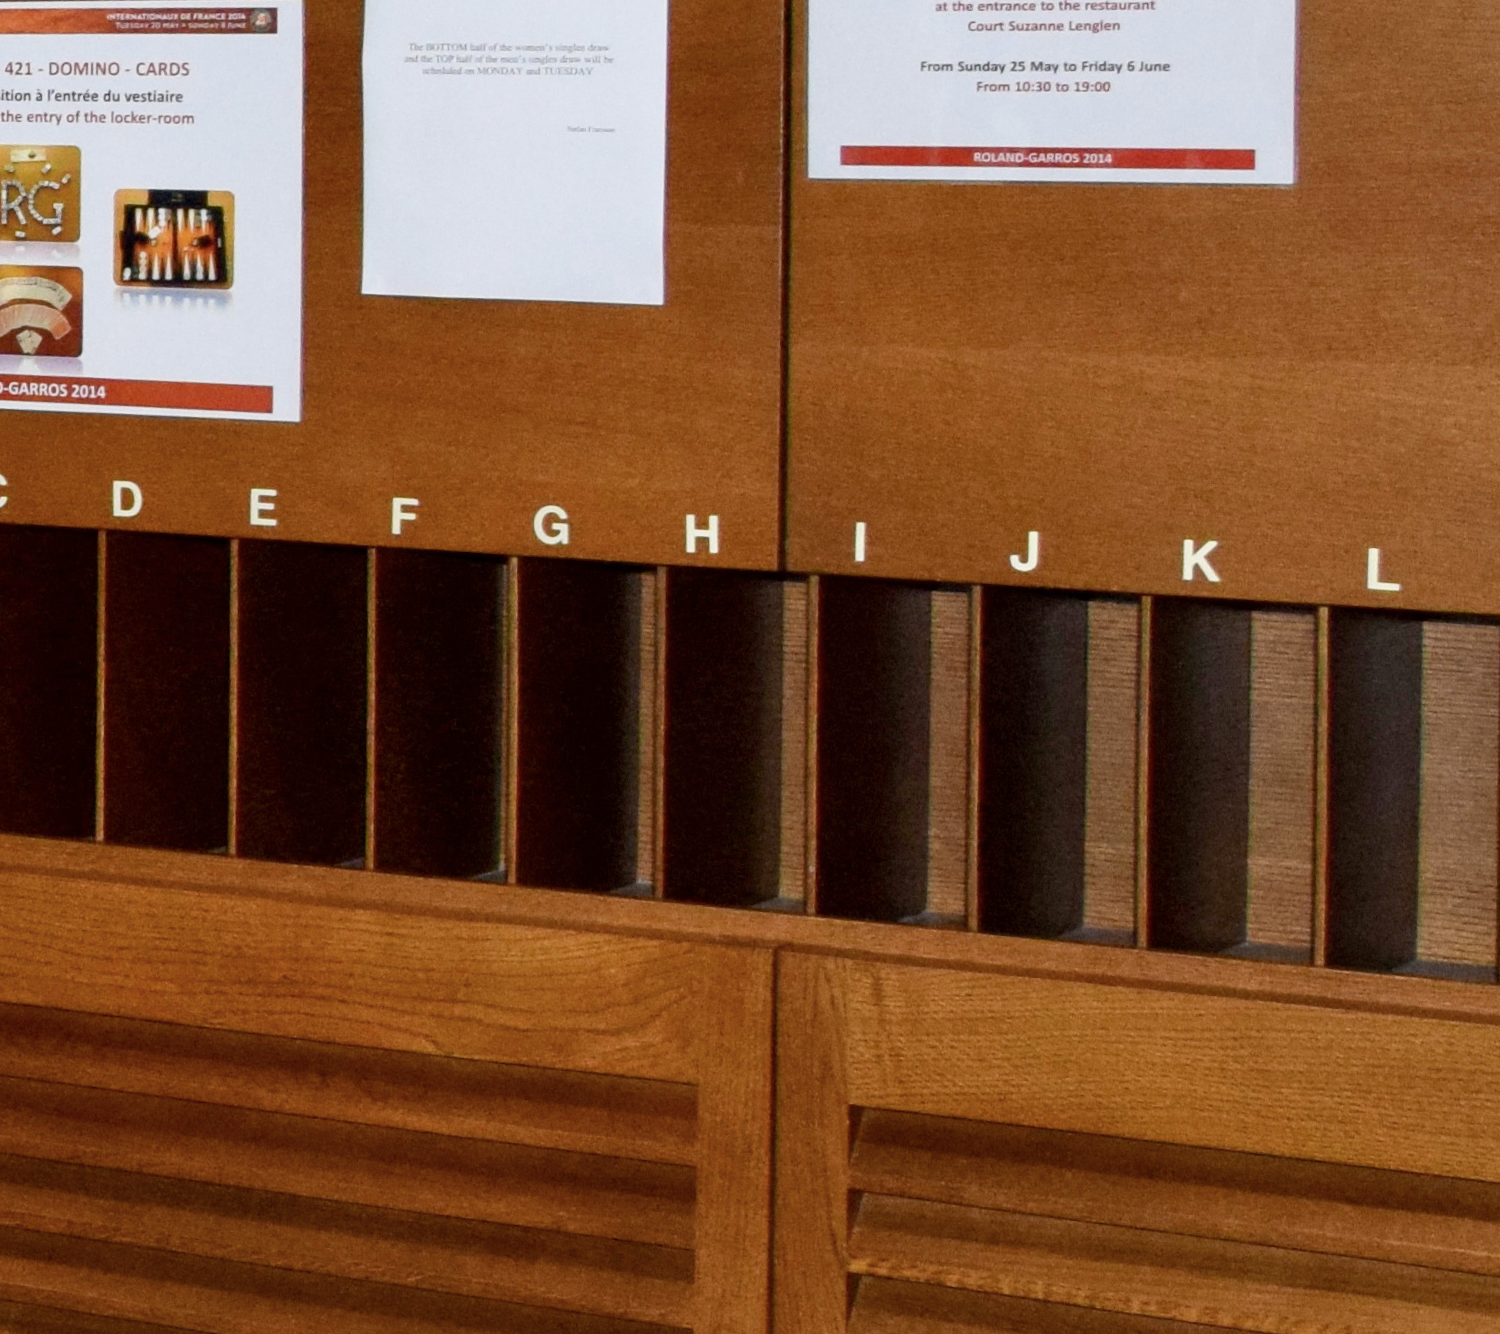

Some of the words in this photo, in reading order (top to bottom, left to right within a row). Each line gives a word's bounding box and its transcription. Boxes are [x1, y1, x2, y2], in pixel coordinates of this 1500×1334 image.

[935, 2, 948, 12] at
[951, 0, 973, 12] the
[977, 1, 1036, 11] entrance
[1040, 1, 1054, 11] to
[1058, 0, 1081, 11] the
[1084, 0, 1156, 11] restaurant
[967, 20, 1004, 32] Court
[1008, 20, 1064, 32] Suzanne
[1068, 20, 1121, 34] Lenglen
[4, 61, 32, 75] 421
[48, 61, 120, 76] DOMINO
[135, 61, 190, 76] CARDS
[920, 60, 953, 72] From
[957, 60, 1006, 74] Sunday
[1009, 60, 1026, 72] 25
[1029, 60, 1059, 74] May
[1063, 61, 1077, 72] to
[1081, 60, 1123, 74] Friday
[1126, 60, 1135, 72] 6
[1138, 61, 1170, 72] June
[976, 81, 1010, 92] From
[1015, 81, 1051, 92] 10:30
[1055, 82, 1069, 92] to
[1074, 81, 1111, 92] 19:00
[35, 88, 43, 102] à
[47, 89, 99, 102] l'entrée
[103, 89, 120, 102] du
[124, 90, 183, 103] vestiaire
[0, 109, 23, 123] the
[26, 112, 62, 125] entry
[65, 110, 80, 123] of
[83, 110, 106, 123] the
[110, 111, 194, 124] locker-room
[973, 151, 1080, 163] ROLAND-GARROS
[1082, 152, 1112, 164] 2014
[70, 384, 106, 398] 2014
[113, 481, 142, 517] D
[250, 489, 277, 526] E
[392, 498, 419, 534] F
[534, 505, 568, 544] G
[686, 515, 718, 553] H
[855, 522, 865, 562] I
[1010, 531, 1039, 571] J
[1183, 540, 1220, 582] K
[1368, 548, 1400, 591] L
